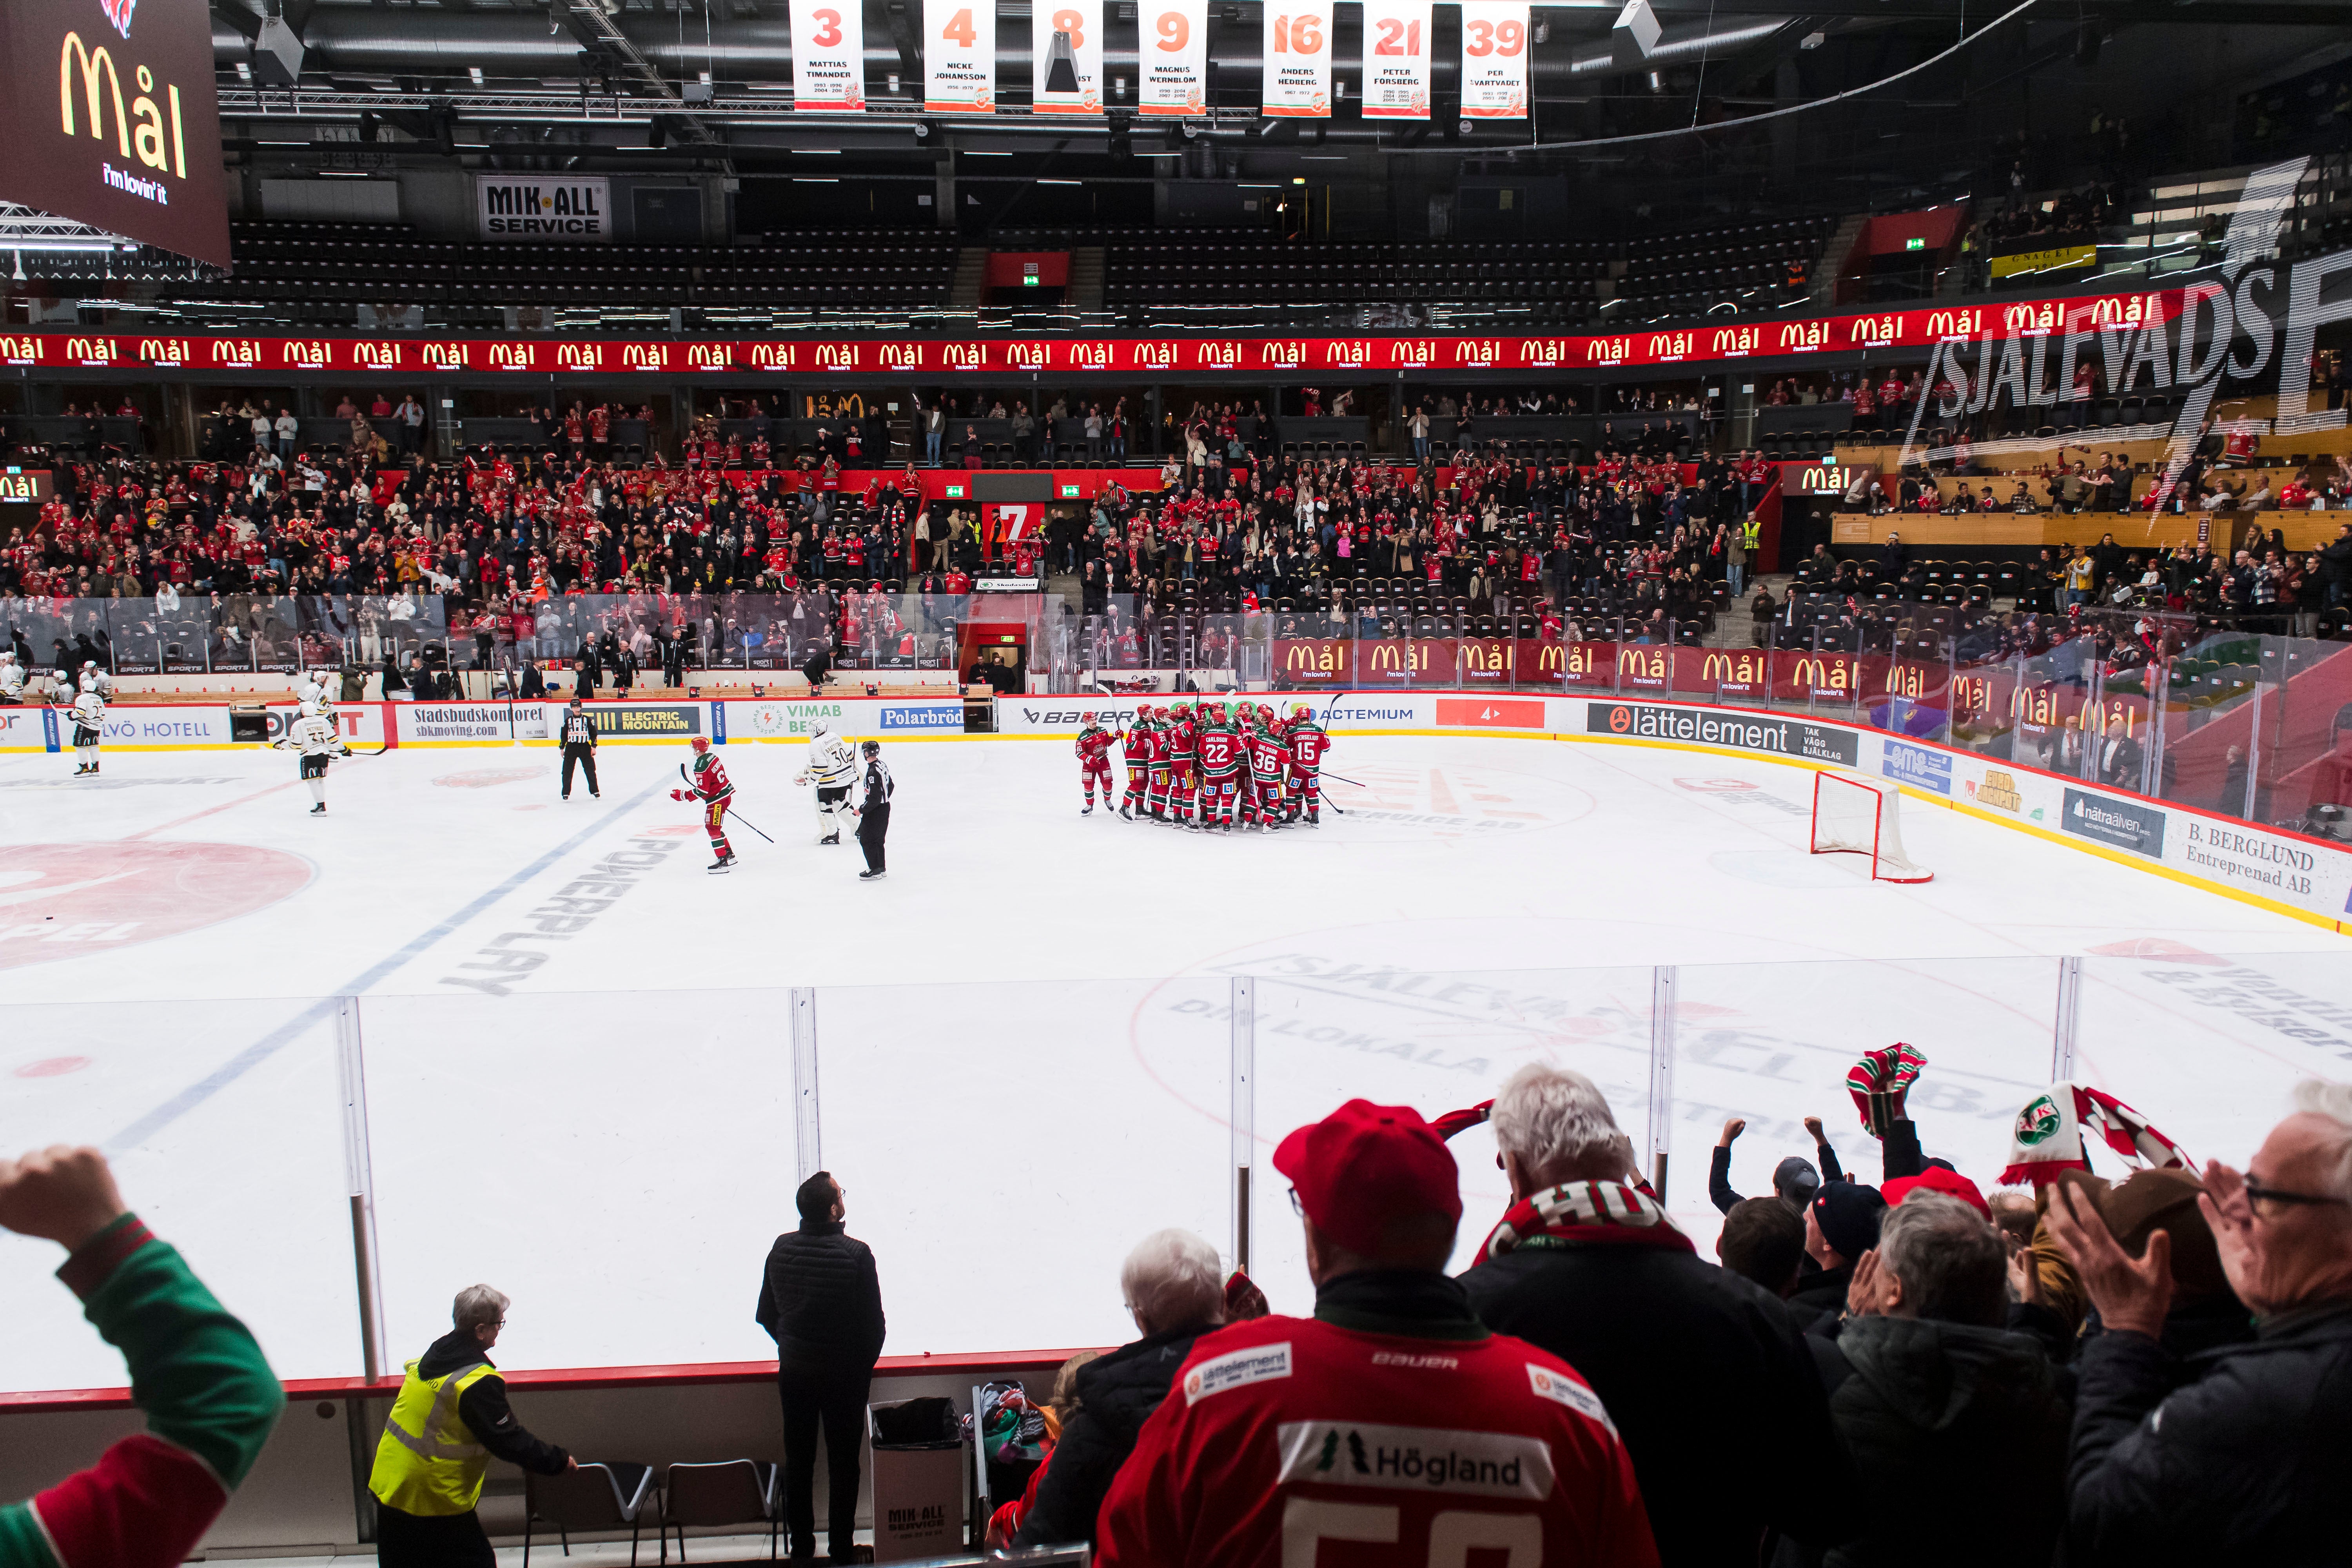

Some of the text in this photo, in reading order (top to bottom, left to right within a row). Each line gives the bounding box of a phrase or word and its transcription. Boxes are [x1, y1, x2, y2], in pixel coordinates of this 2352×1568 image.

[813, 9, 842, 47] 3
[943, 10, 976, 47] 4
[1157, 13, 1189, 52] 9
[1275, 15, 1322, 54] 16
[1375, 20, 1419, 55] 21
[1467, 21, 1524, 56] 39
[61, 31, 185, 179] Mål
[123, 170, 156, 200] lovin'
[157, 183, 167, 205] it
[487, 187, 600, 216] MIK ALL
[487, 218, 601, 234] SERVICE
[2007, 303, 2064, 330] Mål
[2092, 296, 2153, 324] Mål
[1851, 316, 1902, 341] Mål
[0, 338, 43, 358] Mål
[67, 339, 116, 359] Mål
[141, 340, 189, 360] Mål
[1588, 339, 1629, 360] Mål
[1713, 328, 1759, 352] Mål
[284, 342, 331, 362] Mål
[423, 344, 468, 364] Mål
[558, 345, 602, 365] Mål
[689, 345, 731, 365] Mål
[816, 345, 858, 365] Mål
[944, 344, 986, 364] Mål
[1070, 343, 1112, 363] Mål
[1198, 343, 1241, 363] Mål
[1327, 342, 1370, 362] Mål
[1456, 341, 1499, 361] Mål
[1802, 465, 1850, 489] Mål
[1000, 506, 1027, 540] 7
[1287, 645, 1343, 670] Mål
[1371, 645, 1428, 670] Mål
[1455, 645, 1512, 670] Mål
[1539, 645, 1592, 673] Mål
[1702, 653, 1763, 683] Mål
[1793, 659, 1858, 689] Mål
[1886, 665, 1924, 698] Mål
[1953, 675, 1991, 712] Mål
[414, 706, 543, 724] Stadsbudskontoret
[622, 711, 680, 721] ELECTRIC
[786, 705, 842, 717] VIMAB
[1320, 709, 1413, 720] ACTEMIUM
[1480, 706, 1491, 720] 4
[2010, 686, 2058, 726] Mål
[622, 720, 689, 730] MOUNTAIN
[885, 708, 964, 727] Polarbröd
[143, 722, 211, 737] HOTELL
[308, 732, 325, 743] 33
[416, 725, 497, 738] sbkmoving.com
[1633, 708, 1788, 753] lättelement
[1803, 727, 1819, 737] TAK
[1258, 744, 1278, 755] OHLSSON
[1297, 742, 1315, 760] 15
[1803, 735, 1826, 748] VÄGG
[831, 748, 849, 767] 30
[1205, 744, 1229, 763] 22
[1254, 751, 1277, 772] 36
[1803, 746, 1842, 761] BJÄLKLAG
[1891, 745, 1927, 775] ems
[1985, 770, 2015, 791] EURO
[1976, 784, 2022, 813] JACKPOT
[2085, 806, 2140, 833] nätraälven
[2188, 823, 2314, 873] B. BERGLUND
[2186, 845, 2312, 895] Entreprenad AB
[438, 837, 683, 998] POWERPLAY
[1203, 1349, 1287, 1384] lättelement
[1372, 1350, 1459, 1370] BAUER
[1377, 1445, 1521, 1488] Högland
[888, 1519, 944, 1530] SERVICE
[889, 1505, 944, 1523] MIK ALL
